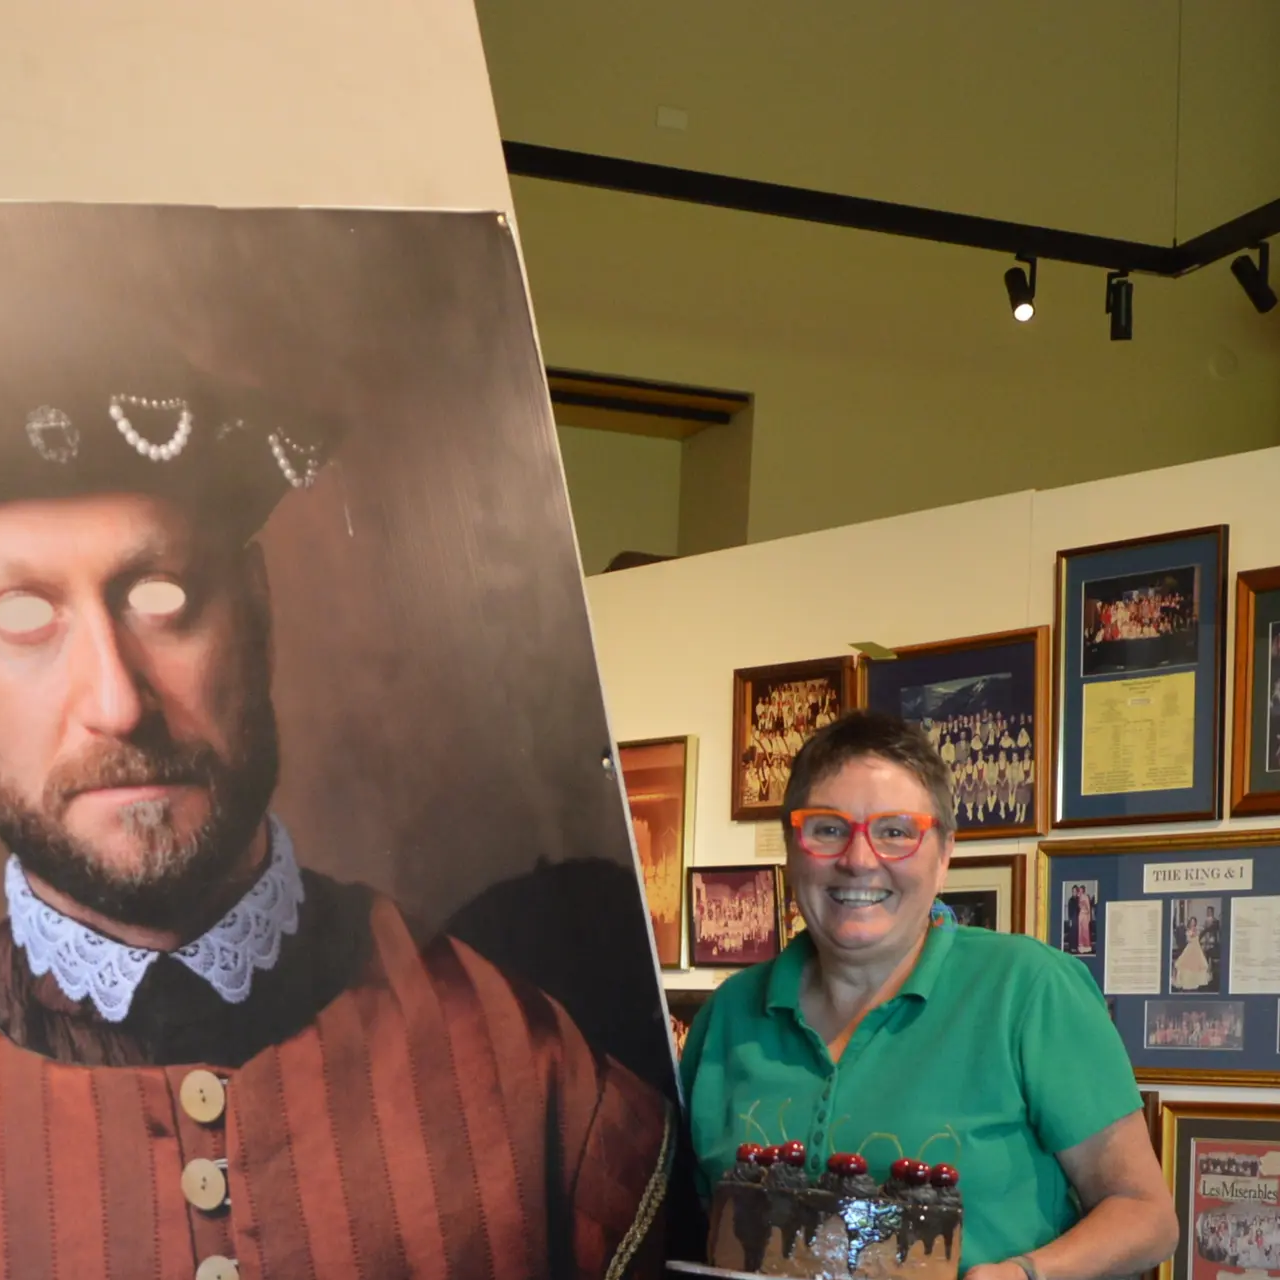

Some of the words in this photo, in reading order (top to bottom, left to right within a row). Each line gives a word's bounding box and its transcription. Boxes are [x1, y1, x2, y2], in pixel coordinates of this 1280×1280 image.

[1153, 869, 1181, 882] THE
[1185, 867, 1221, 881] KING
[1224, 867, 1235, 879] &
[1239, 865, 1244, 879] I
[1202, 1180, 1220, 1197] Les
